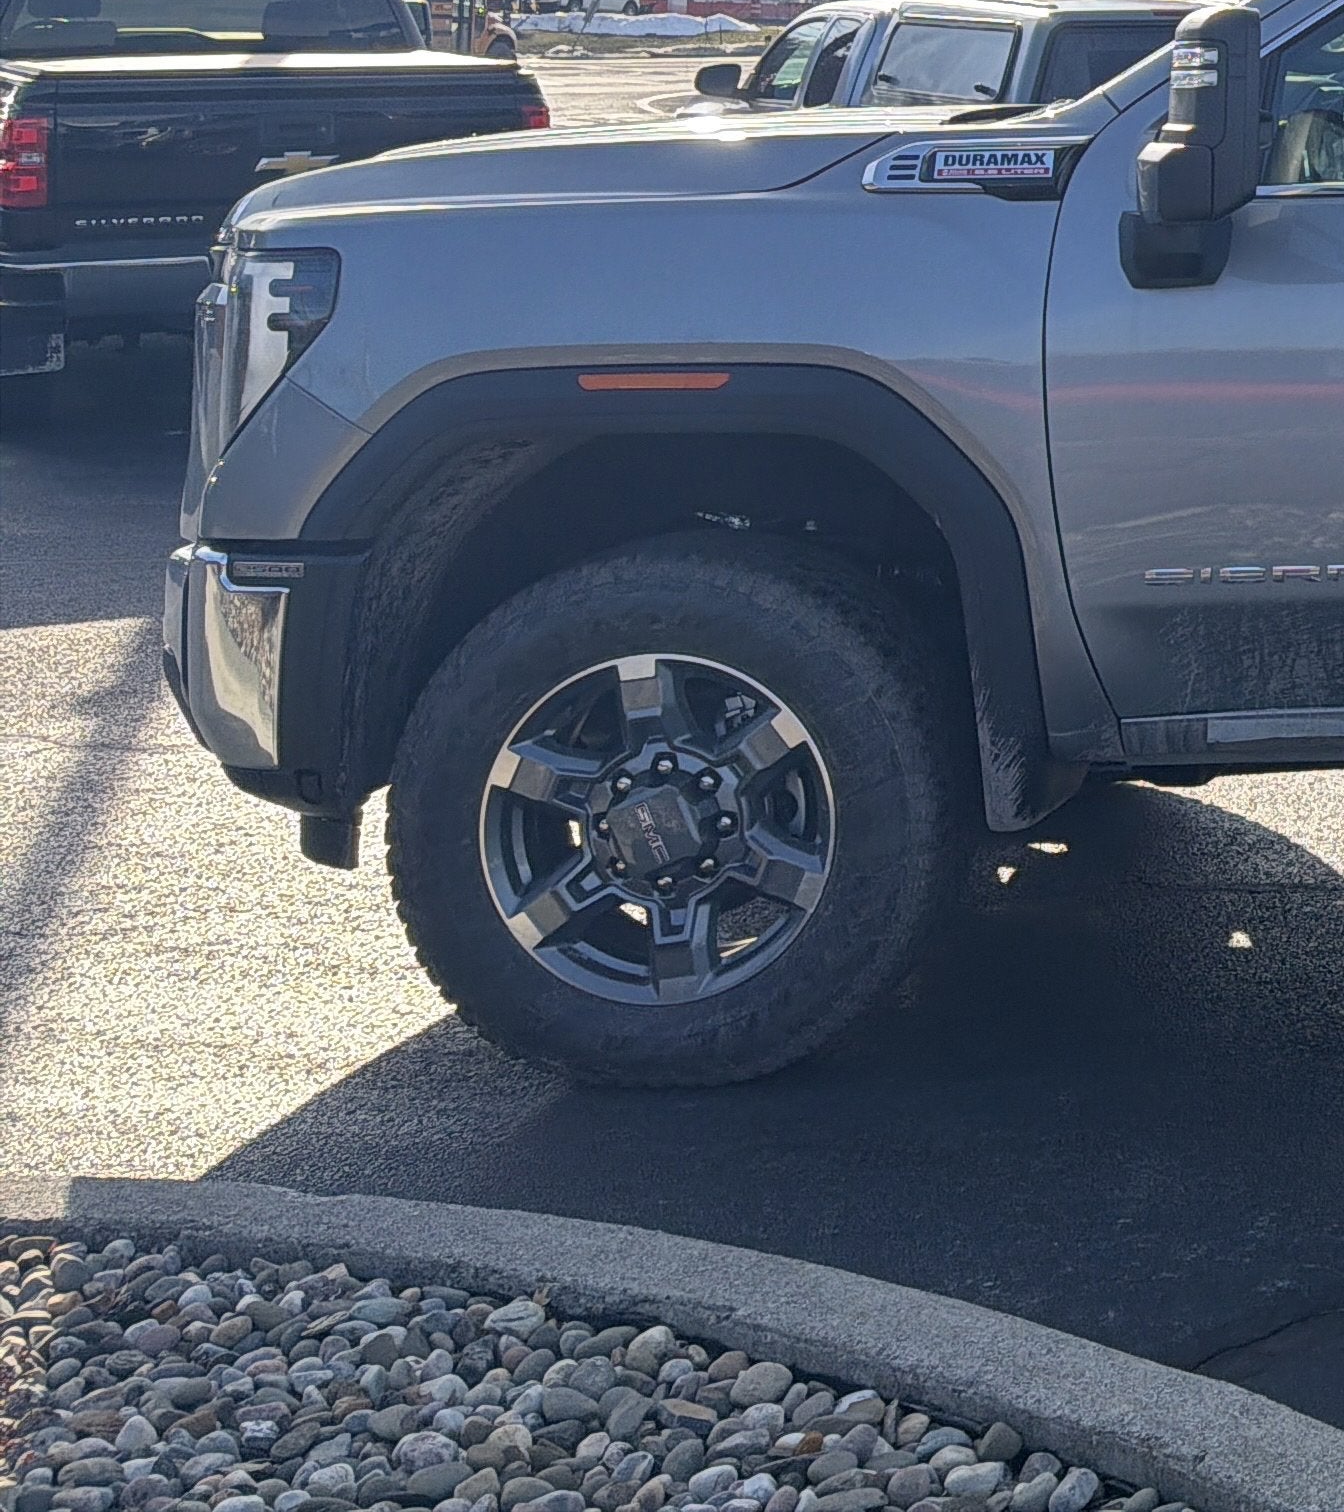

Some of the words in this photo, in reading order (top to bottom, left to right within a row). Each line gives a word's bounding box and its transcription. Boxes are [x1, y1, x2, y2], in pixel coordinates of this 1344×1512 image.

[943, 152, 1047, 167] DURAMAX
[75, 215, 204, 228] SILVERADO
[635, 801, 670, 864] GMC
